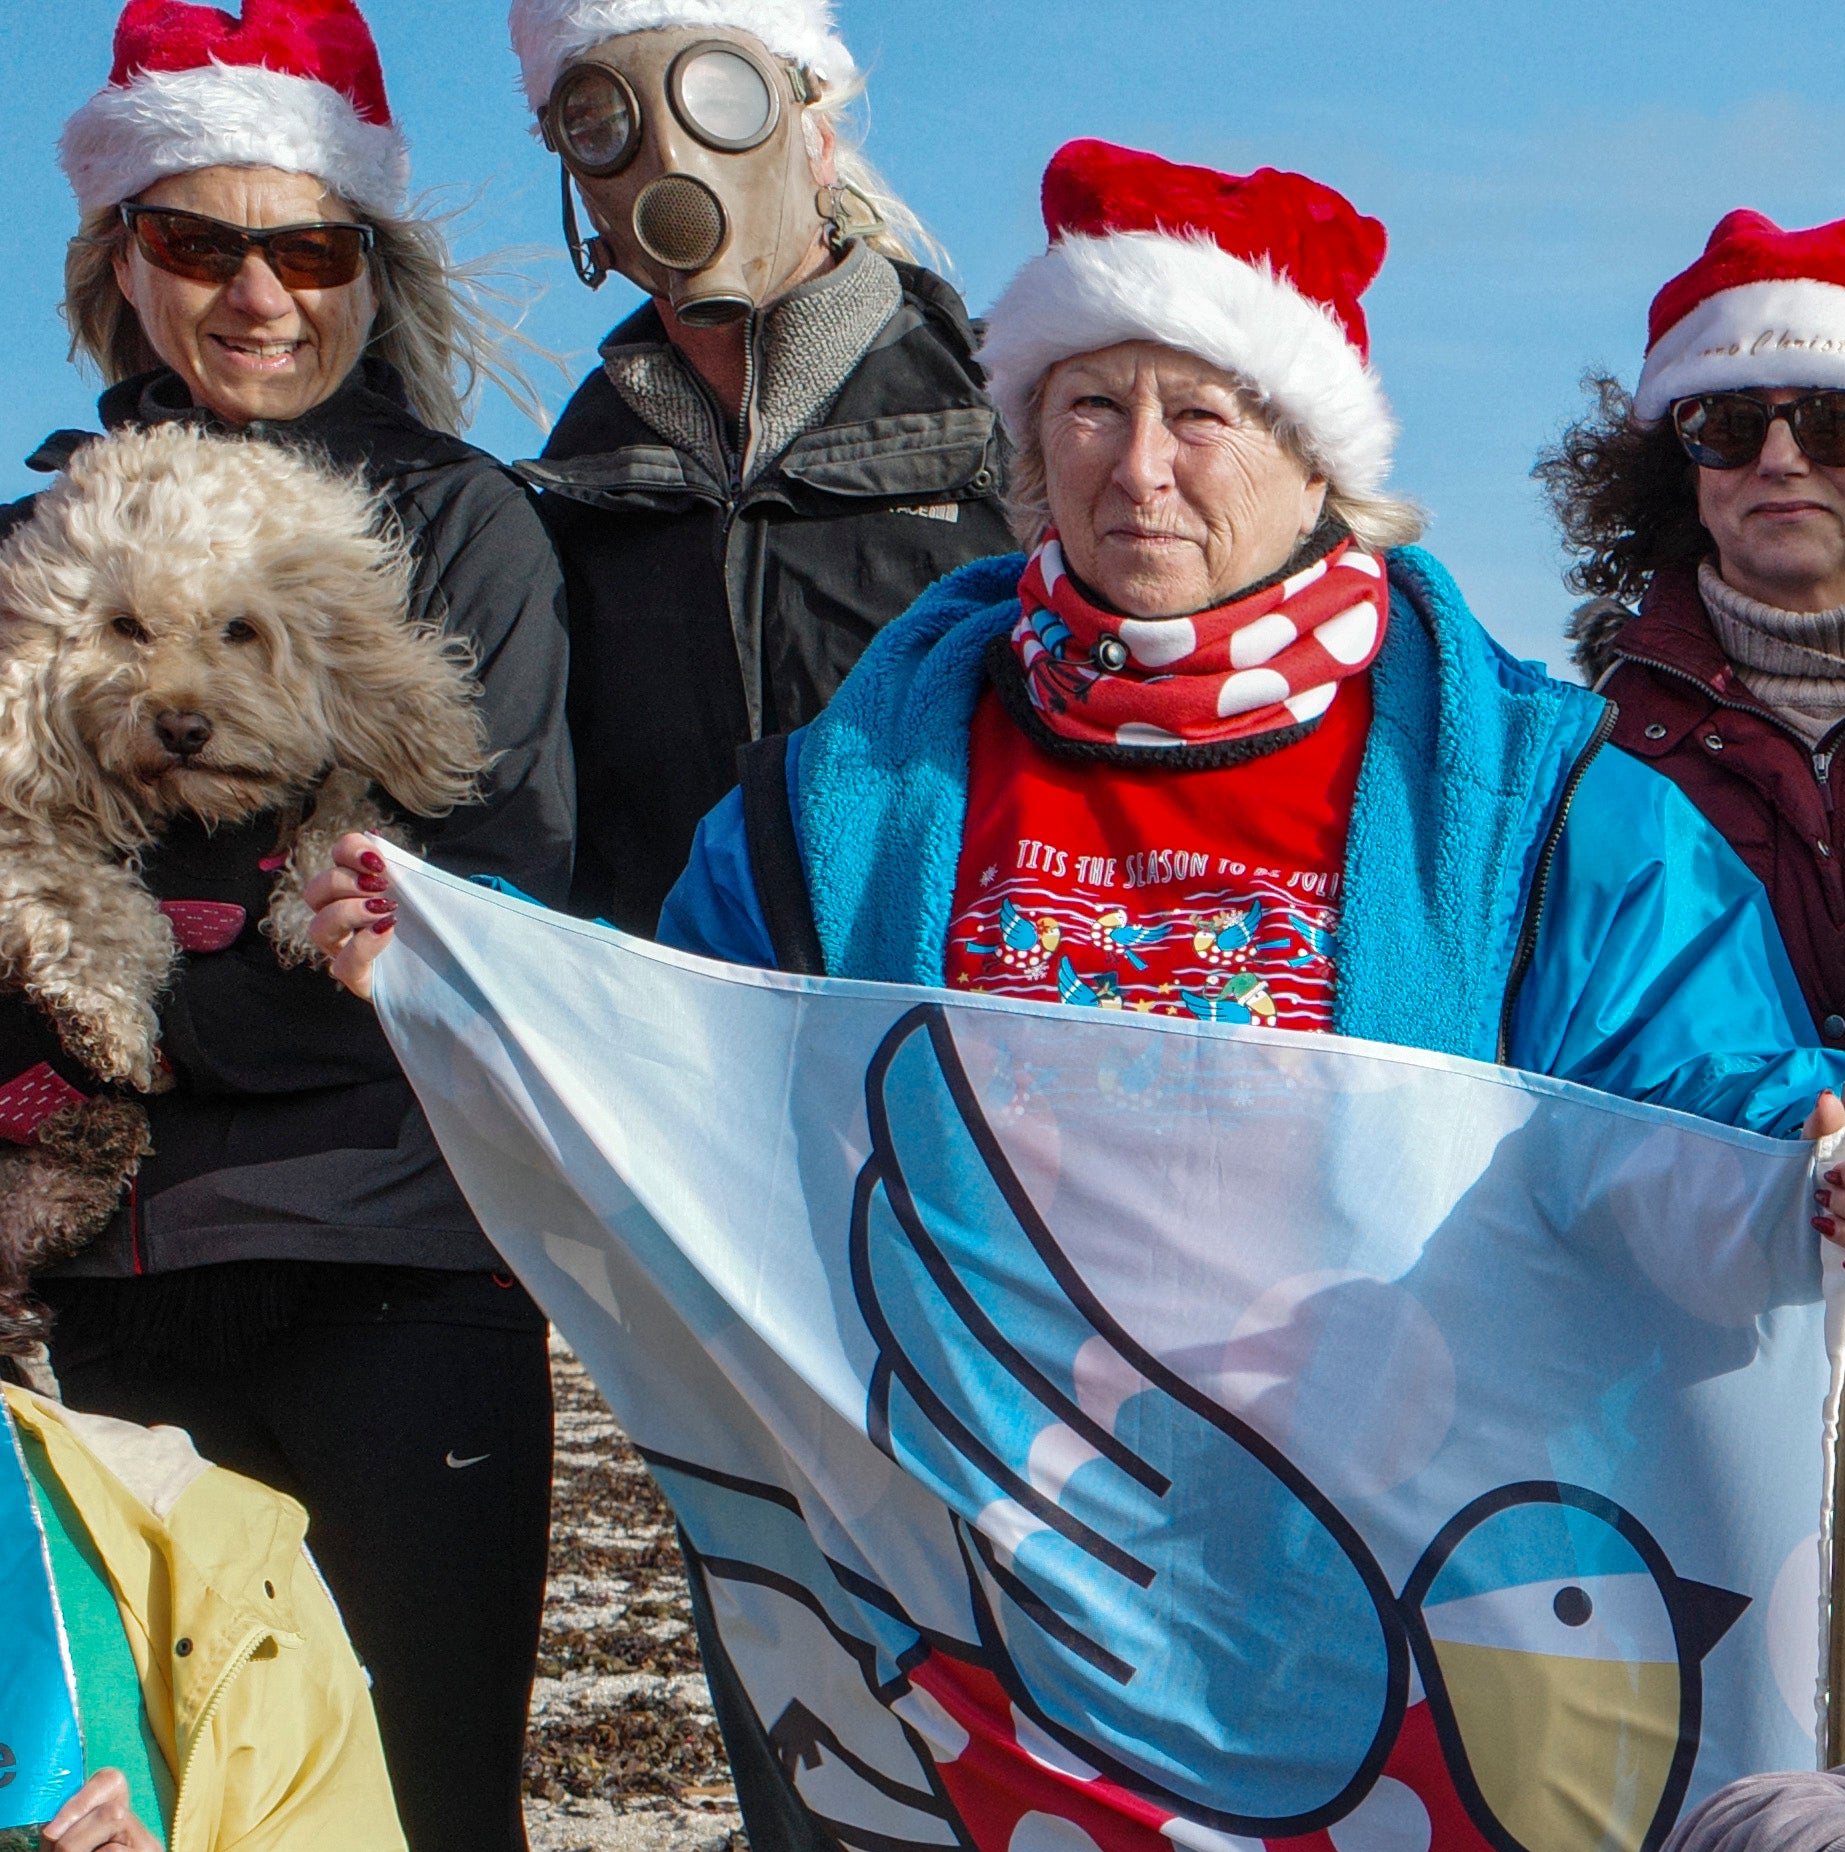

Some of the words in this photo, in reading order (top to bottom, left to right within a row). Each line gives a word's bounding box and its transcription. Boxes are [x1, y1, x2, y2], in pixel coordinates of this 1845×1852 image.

[1016, 839, 1069, 877] TITS
[1077, 855, 1117, 887] THE
[1123, 848, 1210, 889] SEASON
[1217, 858, 1246, 876] TO
